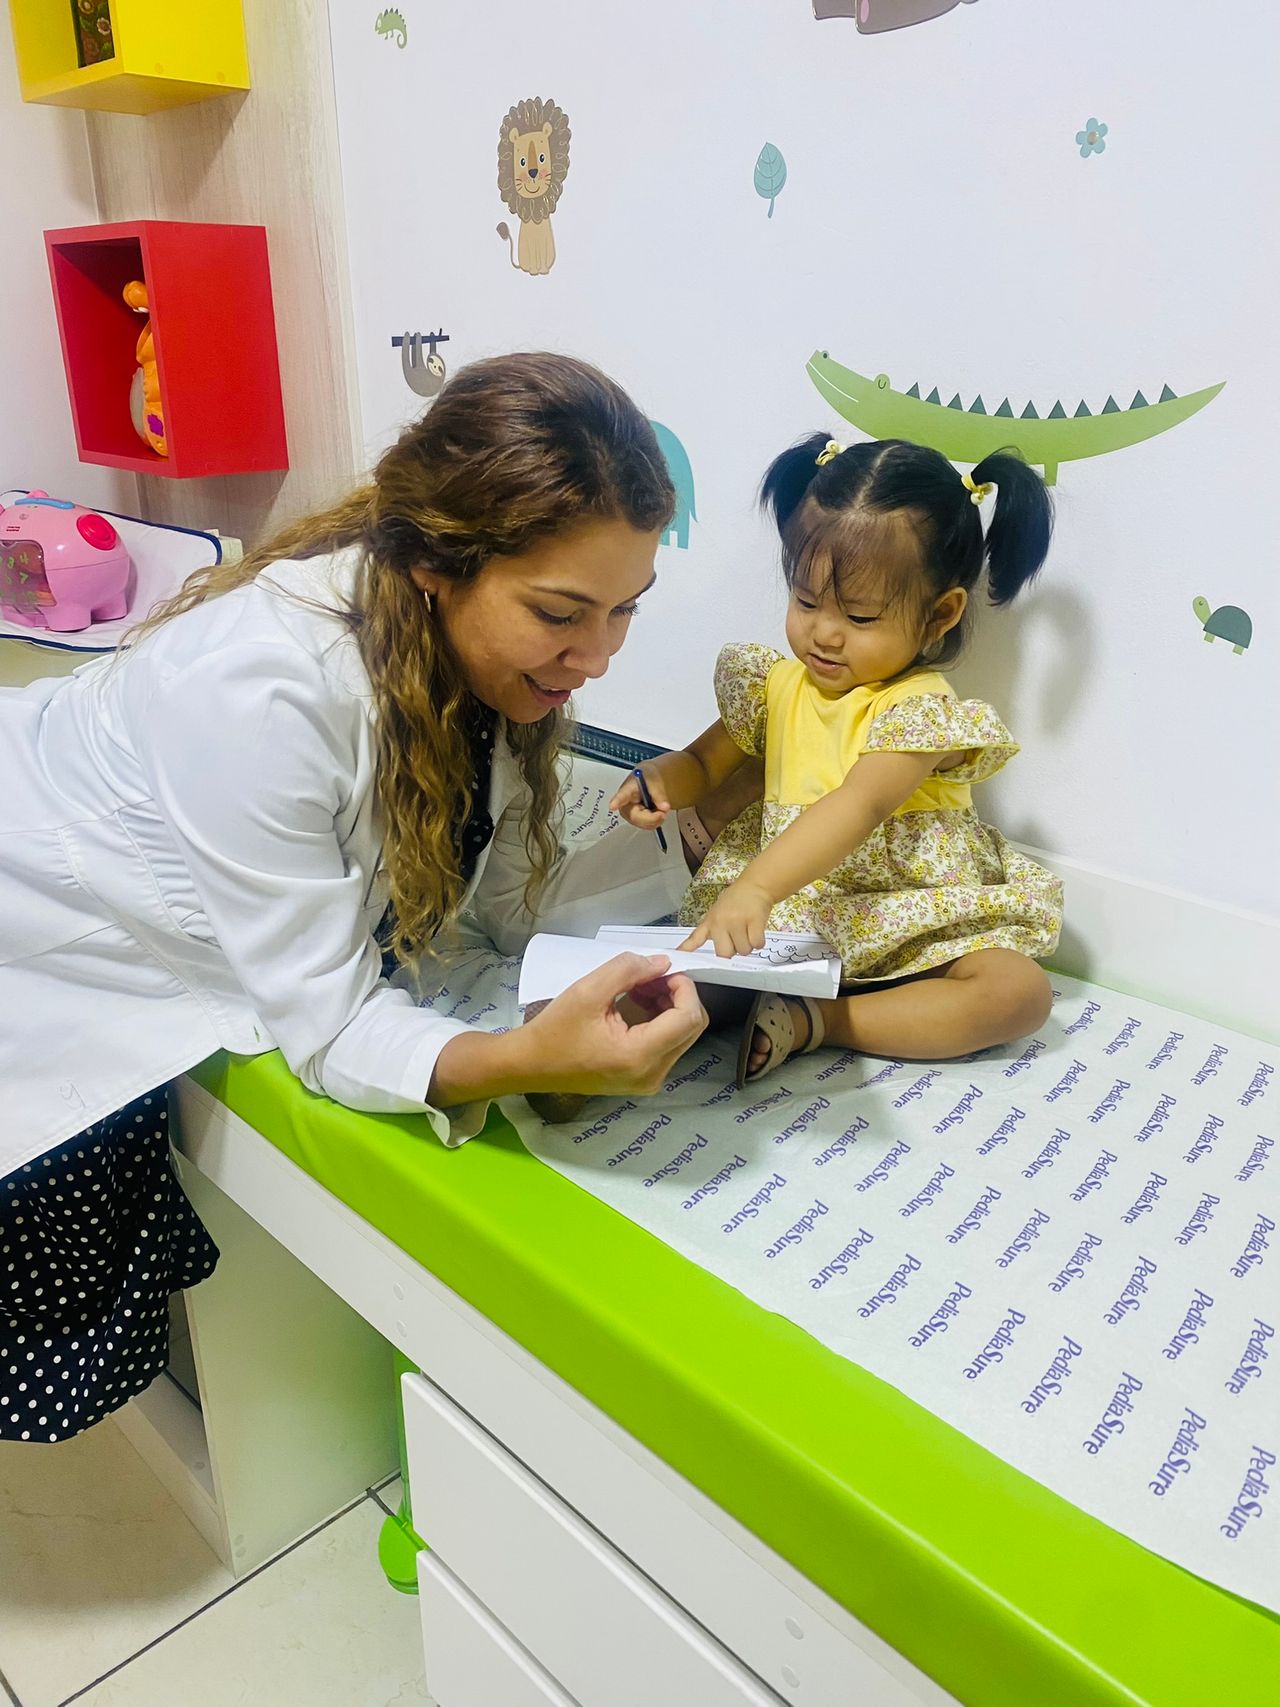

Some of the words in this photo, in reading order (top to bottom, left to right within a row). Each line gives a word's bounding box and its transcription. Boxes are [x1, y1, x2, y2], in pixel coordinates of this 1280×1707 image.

[1062, 1001, 1101, 1035] PediaSure
[1102, 1017, 1142, 1055] PediaSure
[664, 1054, 721, 1092] PediaSure
[1002, 1040, 1047, 1077] PediaSure
[1145, 1031, 1184, 1070] PediaSure
[1190, 1044, 1228, 1085] PediaSure
[891, 1069, 943, 1109] PediaSure
[1043, 1059, 1087, 1102] PediaSure
[1087, 1079, 1131, 1123] PediaSure
[1237, 1061, 1274, 1106] PediaSure
[572, 1100, 638, 1143] PediaSure
[773, 1096, 831, 1144] PediaSure
[932, 1084, 983, 1133] PediaSure
[976, 1106, 1026, 1155] PediaSure
[1133, 1093, 1176, 1142] PediaSure
[606, 1114, 672, 1166] PediaSure
[642, 1133, 708, 1187] PediaSure
[812, 1116, 869, 1166] PediaSure
[1021, 1128, 1071, 1178] PediaSure
[1182, 1114, 1224, 1163] PediaSure
[1234, 1135, 1274, 1181] PediaSure
[681, 1154, 748, 1209] PediaSure
[853, 1140, 911, 1192] PediaSure
[898, 1162, 955, 1217] PediaSure
[1069, 1149, 1118, 1201] PediaSure
[721, 1173, 787, 1233] PediaSure
[945, 1186, 1002, 1244] PediaSure
[1120, 1172, 1167, 1224] PediaSure
[1174, 1192, 1220, 1245] PediaSure
[764, 1199, 829, 1258] PediaSure
[995, 1208, 1050, 1268] PediaSure
[1230, 1213, 1275, 1278] PediaSure
[809, 1228, 874, 1289] PediaSure
[1048, 1232, 1102, 1292] PediaSure
[857, 1253, 922, 1318] PediaSure
[1103, 1256, 1157, 1325] PediaSure
[908, 1281, 972, 1347] PediaSure
[1162, 1288, 1214, 1360] PediaSure
[962, 1308, 1026, 1380] PediaSure
[1225, 1318, 1275, 1394] PediaSure
[1021, 1335, 1082, 1413] PediaSure
[1083, 1371, 1143, 1454] PediaSure
[1148, 1407, 1206, 1496] PediaSure
[1220, 1445, 1276, 1538] PediaSure
